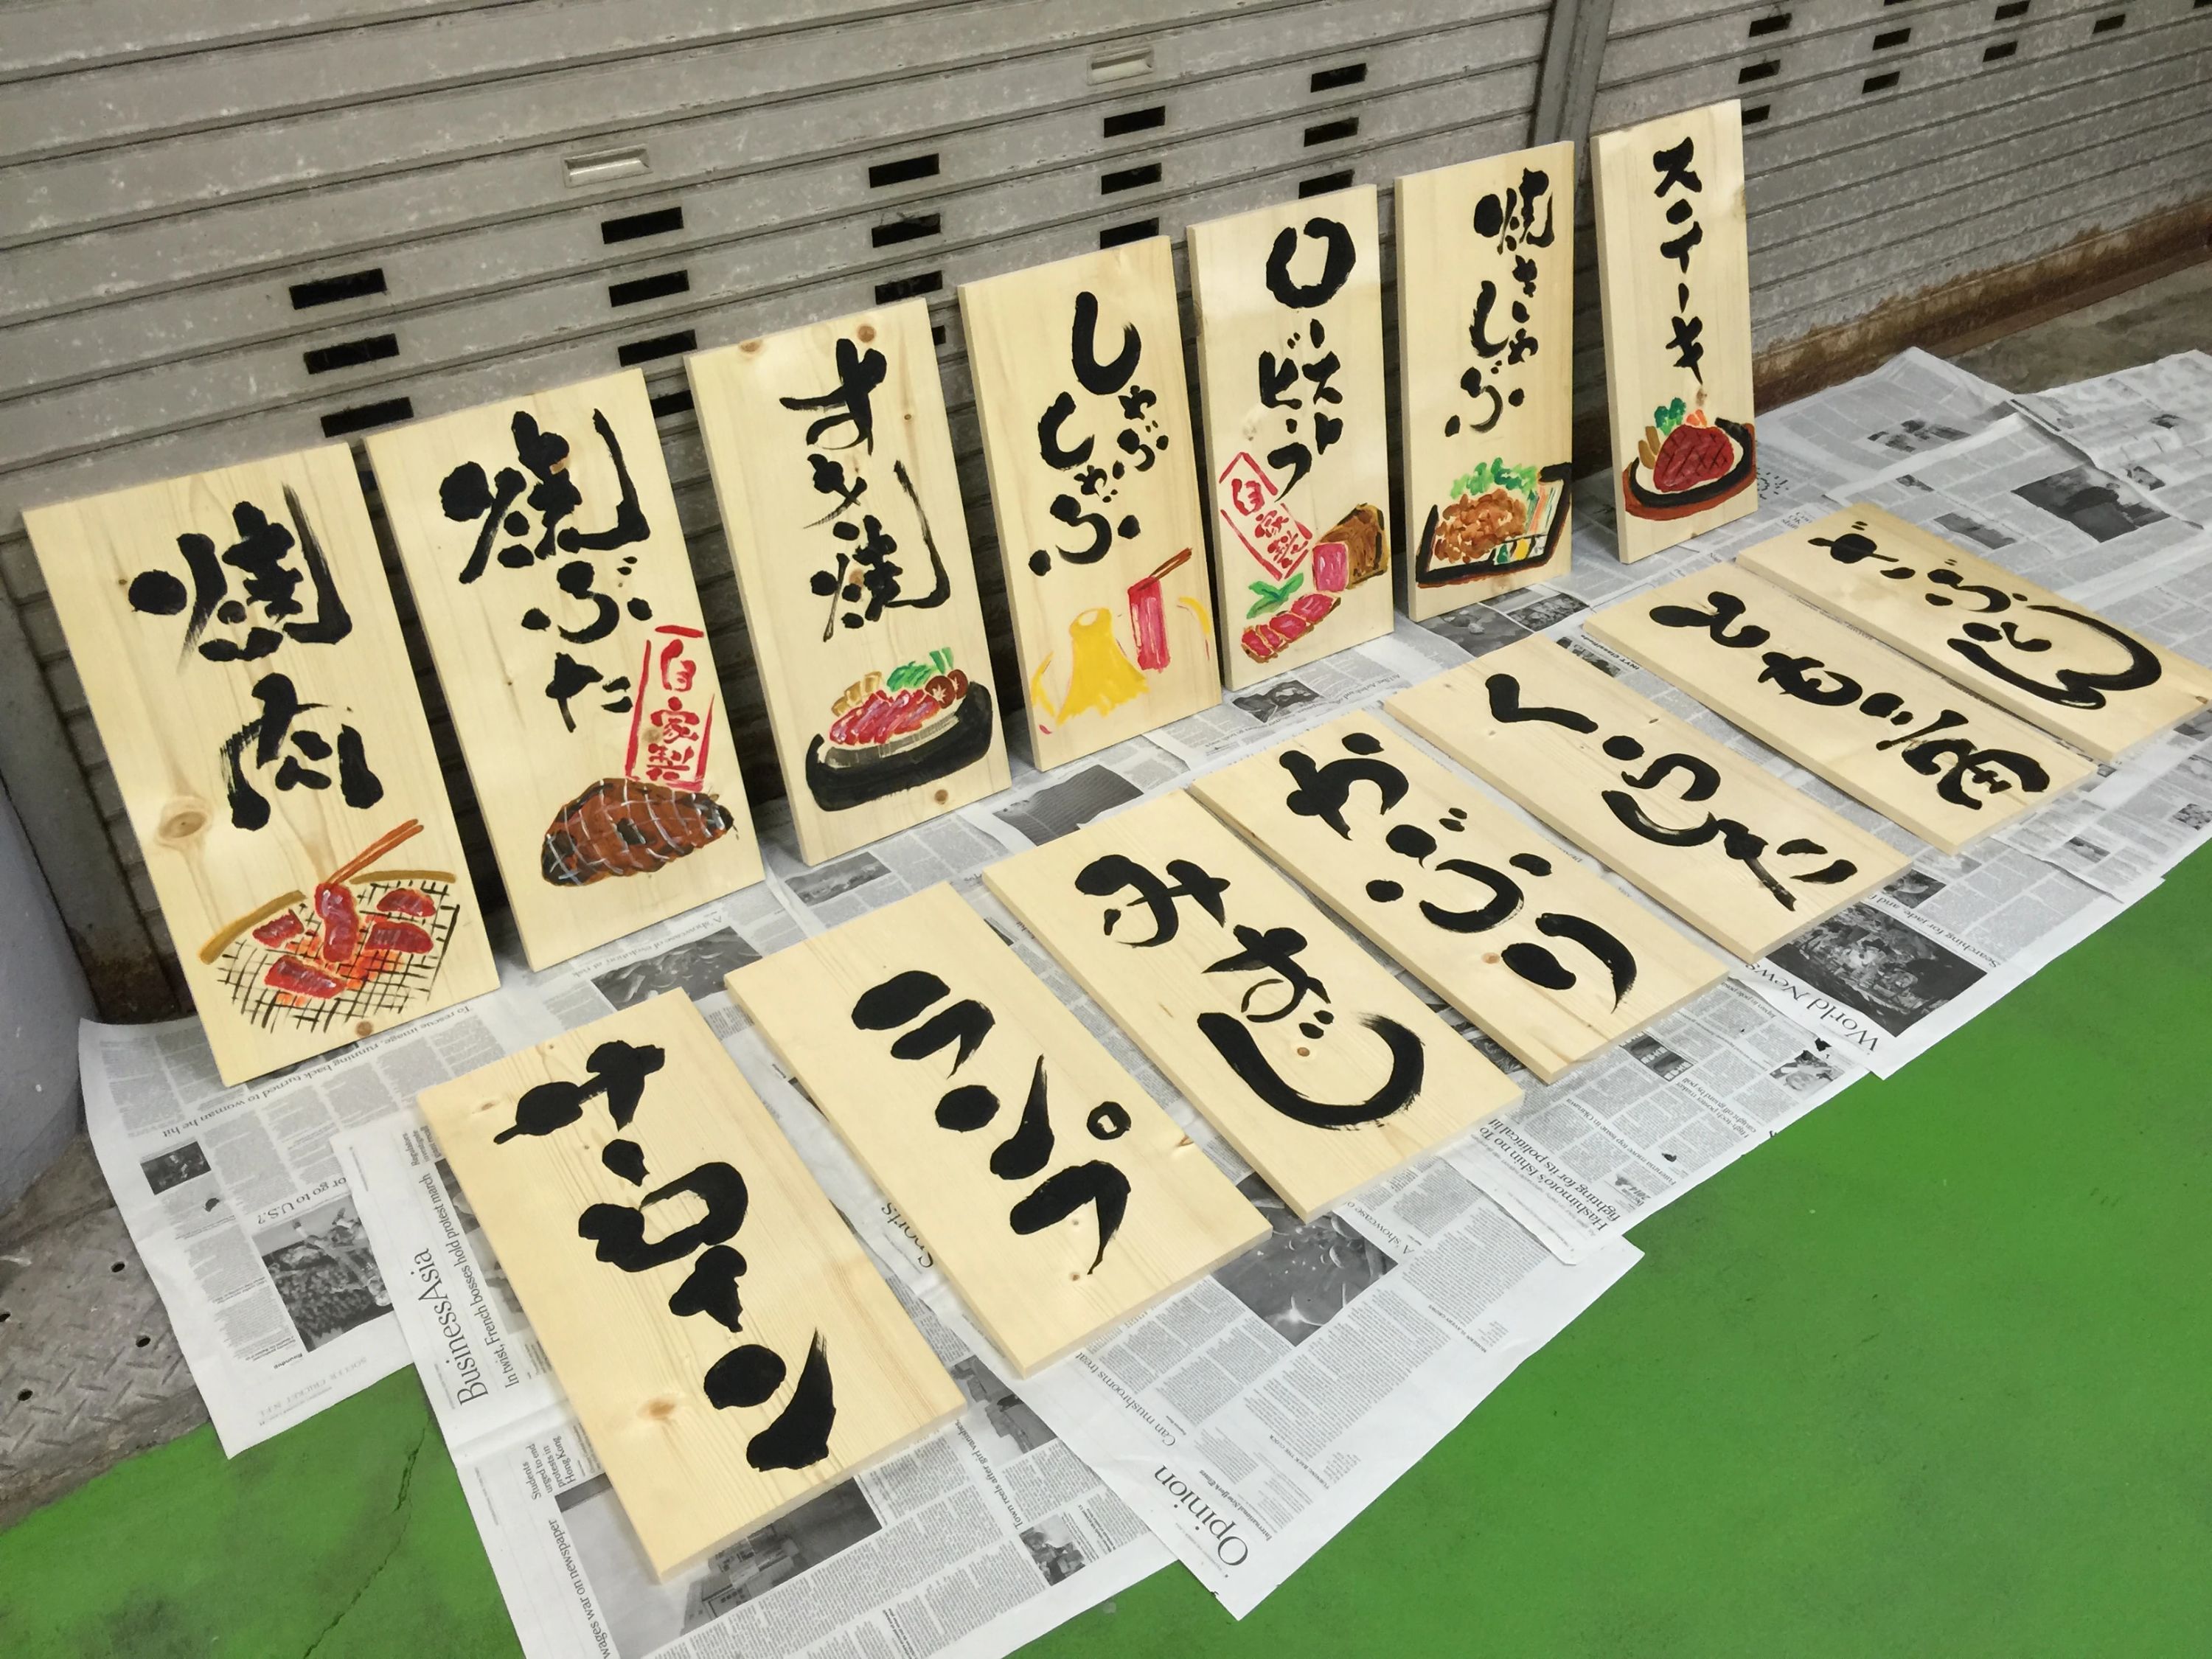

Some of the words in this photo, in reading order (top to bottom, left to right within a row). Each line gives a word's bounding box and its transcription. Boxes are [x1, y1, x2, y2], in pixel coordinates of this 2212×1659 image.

[1652, 136, 1703, 385] ステーキ
[128, 480, 384, 831] 焼肉
[645, 639, 701, 782] 自家製
[1278, 732, 1638, 1015] かぶり
[1876, 897, 1900, 908] and
[1929, 924, 1944, 935] for
[1944, 932, 2000, 967] Searching
[1745, 956, 1810, 1001] News
[1806, 998, 1878, 1051] World
[303, 1065, 333, 1079] back
[262, 1075, 302, 1098] turned
[200, 1100, 246, 1121] woman
[1565, 1098, 1594, 1121] Okinawa
[162, 1126, 181, 1137] hit
[182, 1119, 198, 1129] he
[851, 969, 1132, 1276] ランプ
[1493, 1138, 1512, 1152] no
[1498, 1126, 1548, 1163] political
[1615, 1138, 1628, 1149] top
[1509, 1150, 1539, 1176] Ishin
[1543, 1161, 1559, 1175] its
[312, 1181, 329, 1195] go
[332, 1177, 347, 1187] or
[418, 1172, 442, 1204] march
[1557, 1173, 1576, 1187] for
[296, 1193, 310, 1203] to
[1537, 1174, 1608, 1231] Hashimoto's
[1575, 1183, 1621, 1222] fighting
[257, 1202, 295, 1225] U.S.?
[433, 1203, 459, 1239] protest
[445, 1239, 467, 1267] hold
[493, 1040, 838, 1472] サーロイン
[461, 1265, 484, 1307] bosses
[473, 1304, 501, 1346] French
[493, 1343, 514, 1374] twist,
[1075, 1352, 1099, 1374] treat
[504, 1373, 520, 1388] In
[1097, 1371, 1155, 1425] mushrooms
[549, 1435, 567, 1459] Kong
[1154, 1423, 1175, 1447] Can
[525, 1442, 539, 1458] end
[543, 1444, 552, 1455] in
[971, 1450, 988, 1464] girl
[535, 1458, 543, 1469] to
[547, 1454, 567, 1488] protests
[558, 1457, 577, 1484] Hong
[983, 1465, 998, 1484] after
[522, 1461, 542, 1500] Students
[535, 1468, 553, 1494] urged
[1199, 1470, 1216, 1486] Times
[994, 1484, 1010, 1505] reels
[1214, 1484, 1230, 1498] York
[1227, 1495, 1241, 1508] New
[1007, 1504, 1023, 1530] Town
[1154, 1464, 1249, 1566] Opinion
[1237, 1505, 1272, 1541] International
[548, 1519, 580, 1579] newspaper
[573, 1579, 585, 1595] on
[579, 1596, 595, 1621] war
[590, 1621, 611, 1659] wages
